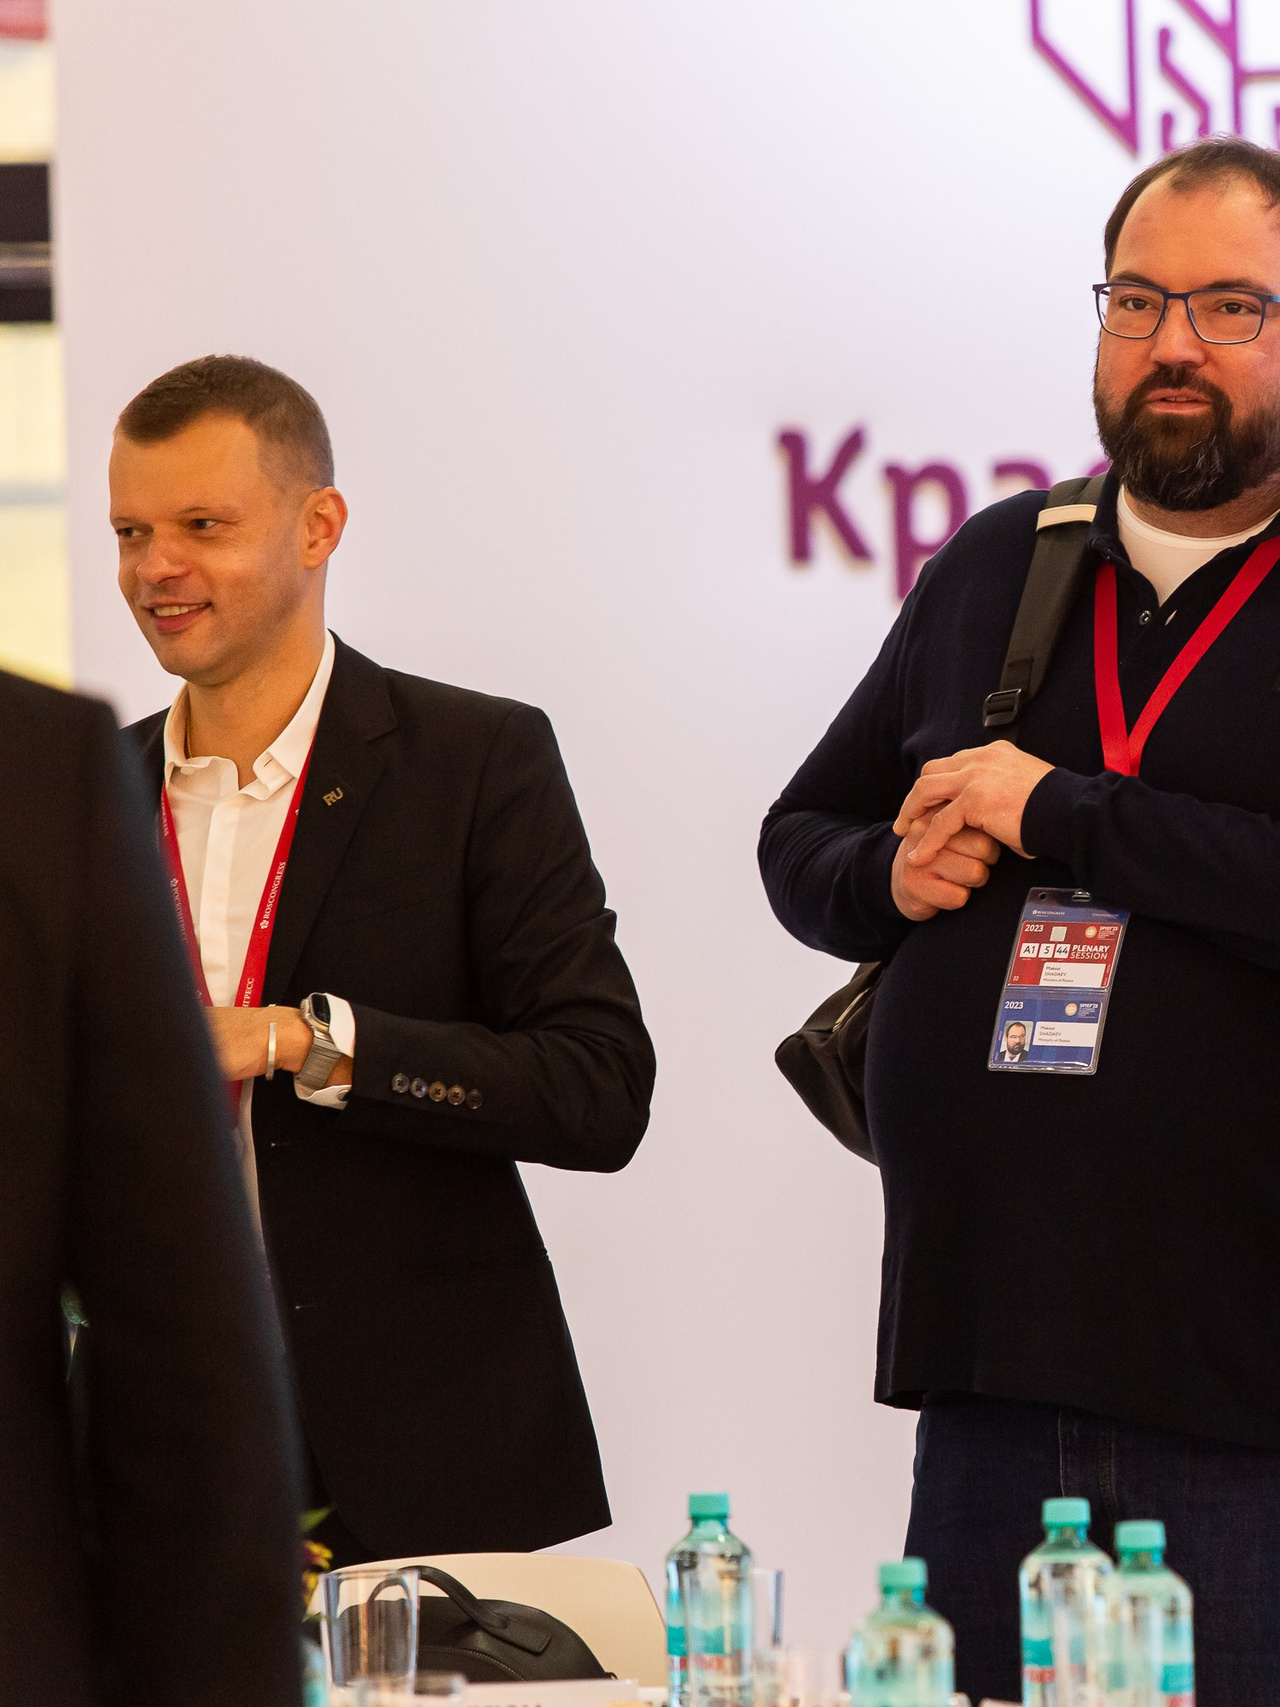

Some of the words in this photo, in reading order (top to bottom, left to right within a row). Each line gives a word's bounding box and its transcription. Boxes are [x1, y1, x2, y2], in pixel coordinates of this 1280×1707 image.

[263, 861, 287, 919] ROSCONGRESS
[1024, 924, 1044, 932] 2023
[1023, 945, 1035, 954] A1
[1043, 945, 1050, 955] 5
[1056, 945, 1068, 955] 44
[1072, 944, 1110, 953] PLENARY
[1070, 951, 1108, 960] SESSION
[1004, 1001, 1024, 1010] 2023
